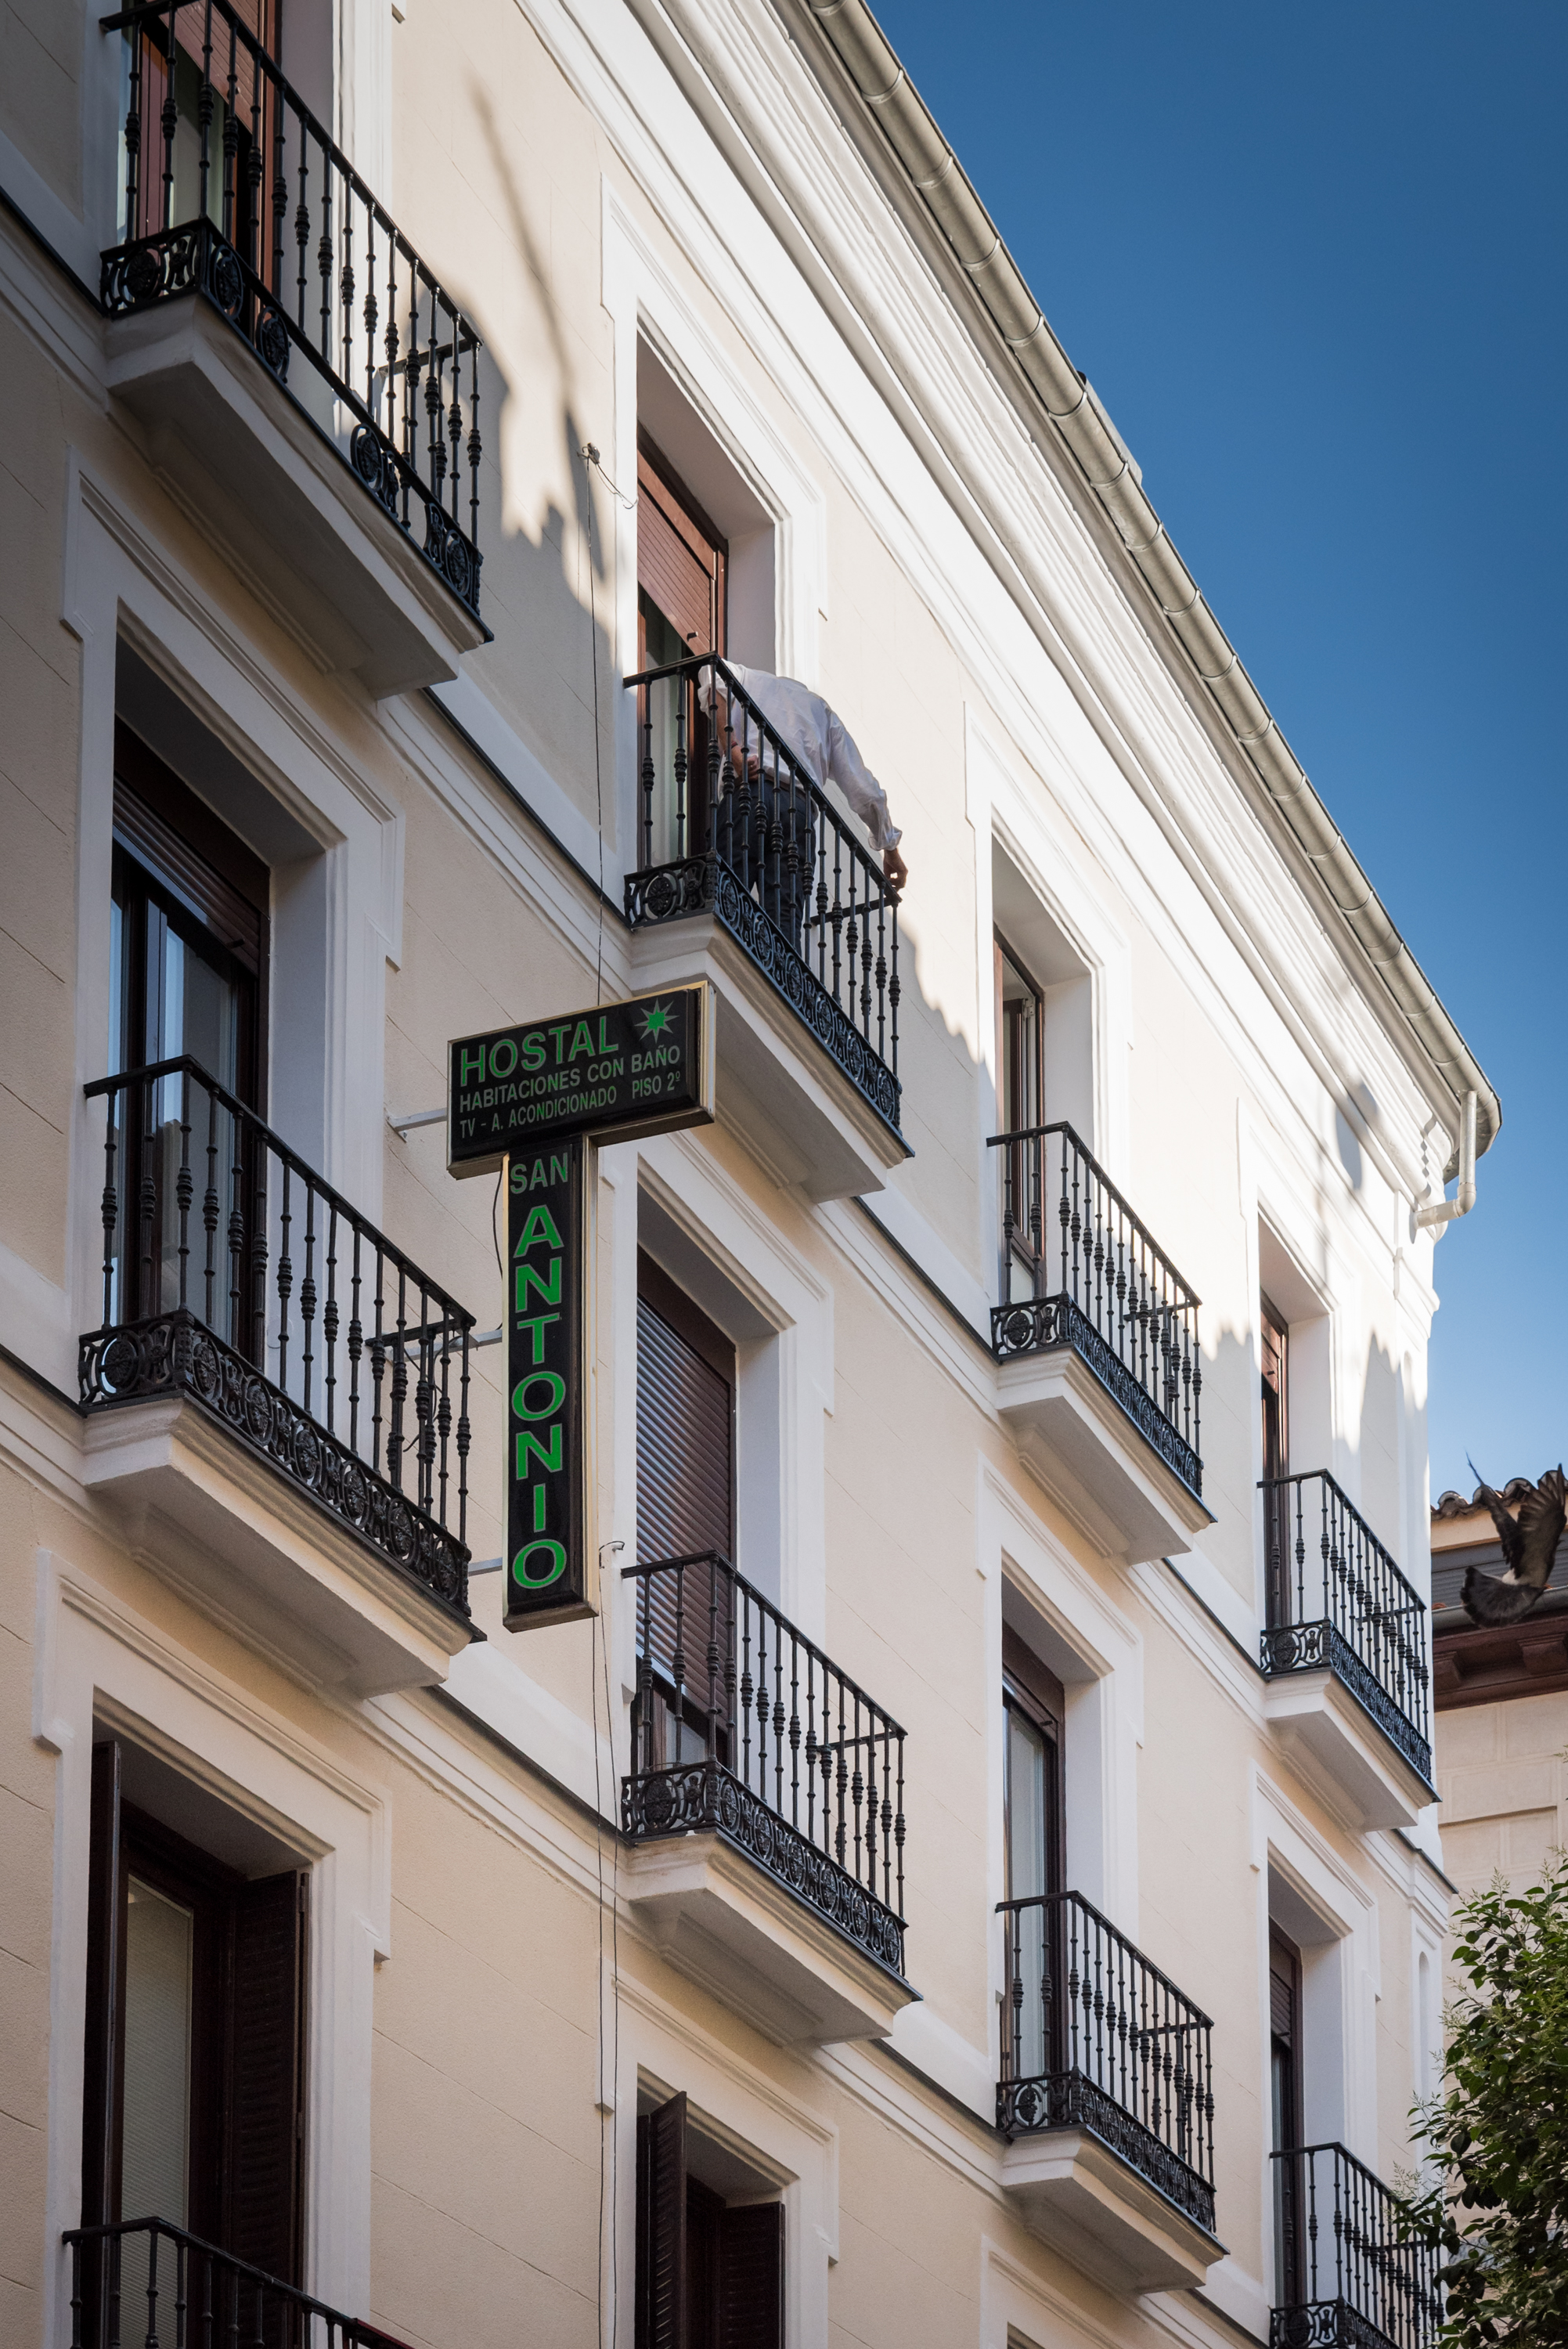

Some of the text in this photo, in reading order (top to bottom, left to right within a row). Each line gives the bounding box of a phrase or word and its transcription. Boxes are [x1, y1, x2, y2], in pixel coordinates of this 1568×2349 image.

[460, 1016, 619, 1087] HOSTAL
[460, 1045, 680, 1113] HABITACIONES CON BAÑO
[460, 1117, 475, 1138] TV
[492, 1113, 503, 1132] A.
[509, 1085, 617, 1128] ACONDICIONADO
[632, 1077, 661, 1099] PISO
[667, 1070, 681, 1092] 2º
[510, 1152, 568, 1194] SAN
[511, 1203, 568, 1589] ANTONIO
